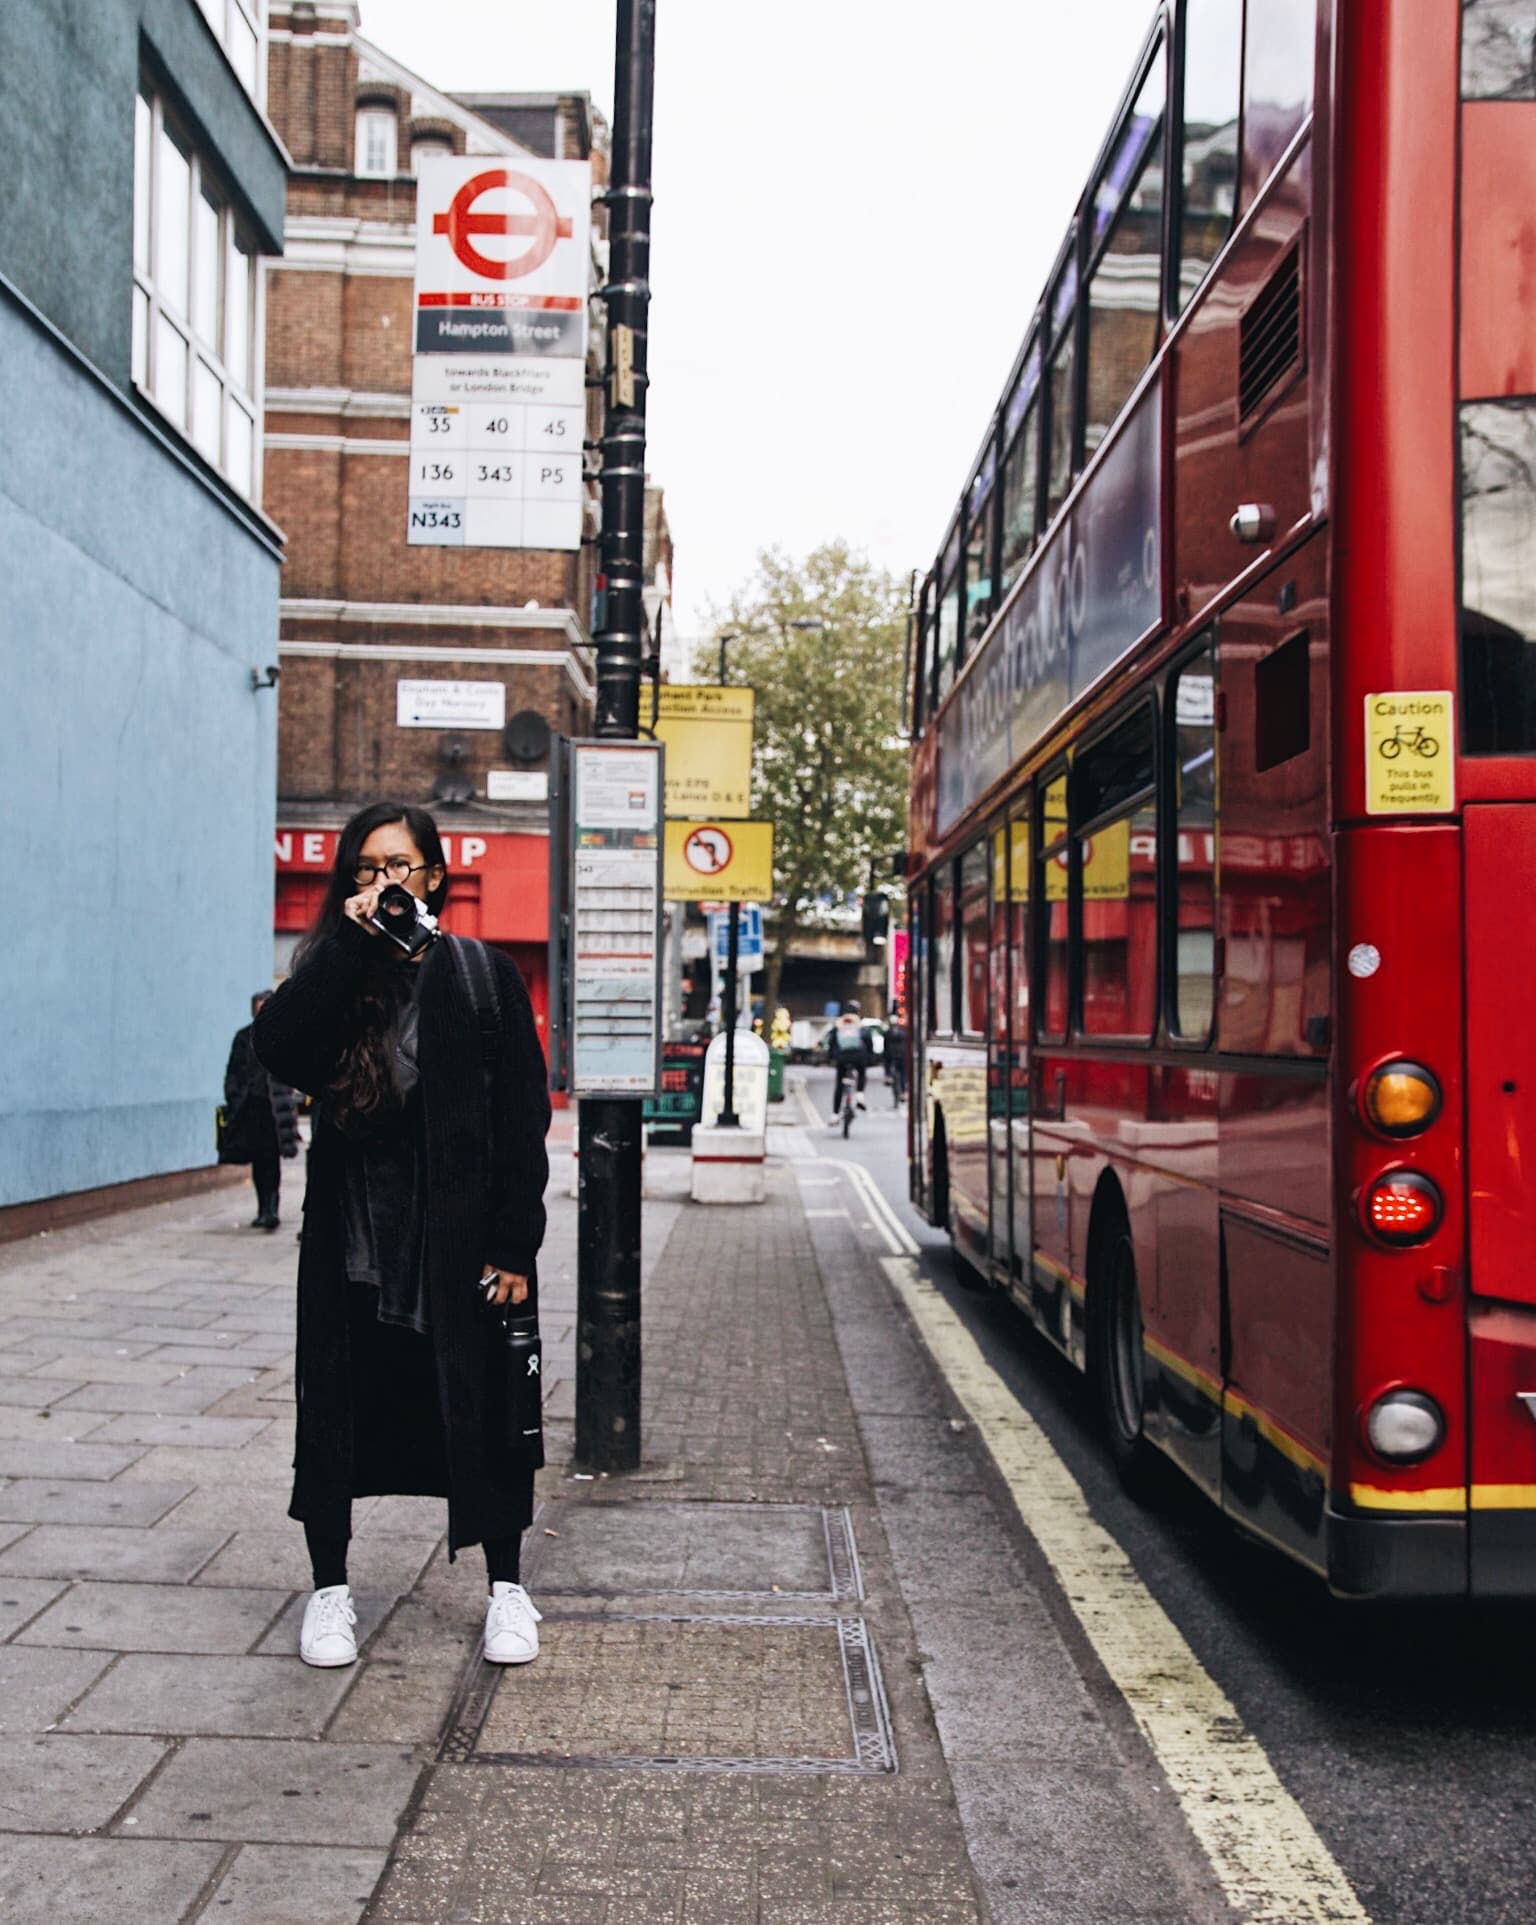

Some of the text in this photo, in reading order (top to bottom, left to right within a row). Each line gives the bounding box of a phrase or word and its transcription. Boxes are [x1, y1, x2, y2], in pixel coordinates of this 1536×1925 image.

[439, 321, 560, 340] Hampton Street
[445, 368, 550, 379] towards Blackfriars
[464, 384, 506, 392] London
[510, 384, 544, 395] Bridge
[428, 417, 566, 436] 35 40 45
[422, 464, 563, 484] 136 343 P5
[412, 512, 461, 529] N343
[1375, 702, 1443, 716] Caution
[1387, 769, 1433, 778] This bus
[1389, 782, 1431, 791] pulls in
[1380, 794, 1440, 804] frequently
